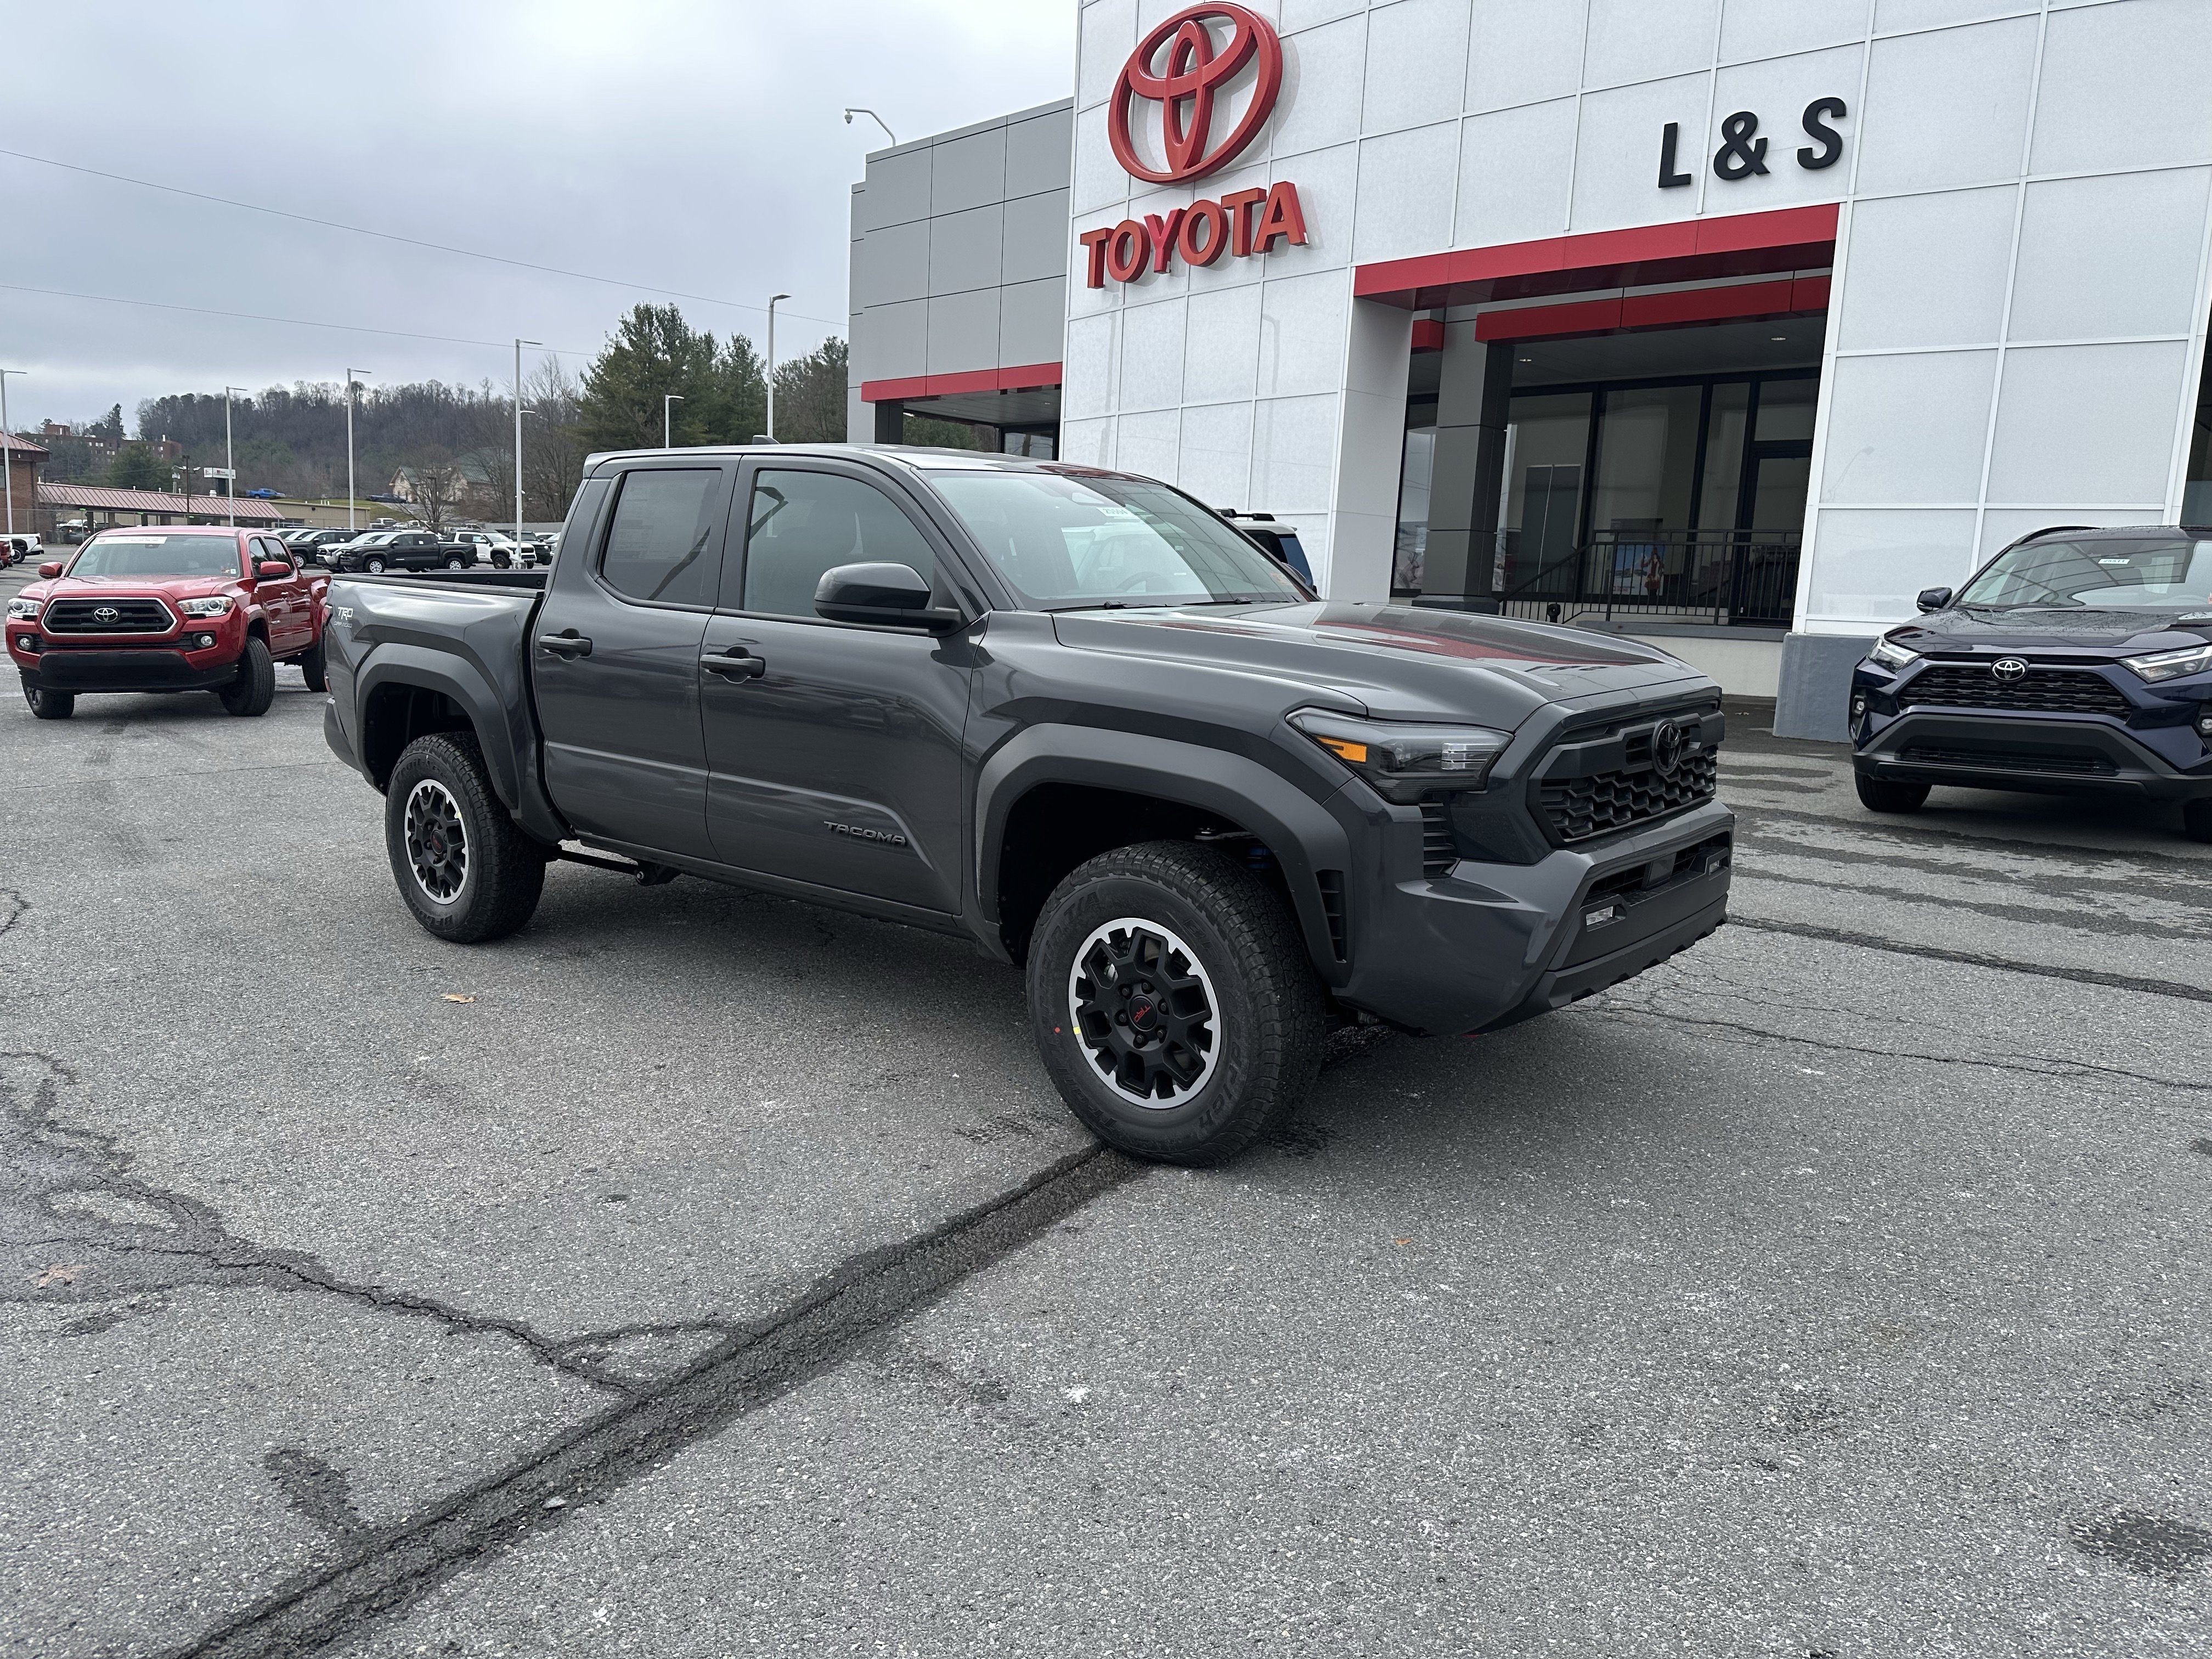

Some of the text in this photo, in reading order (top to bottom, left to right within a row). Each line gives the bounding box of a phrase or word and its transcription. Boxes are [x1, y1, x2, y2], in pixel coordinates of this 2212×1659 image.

[1658, 97, 1846, 188] L & S
[1080, 180, 1309, 289] TOYOTA
[823, 821, 906, 847] TACOMA
[1134, 1005, 1150, 1023] TRD
